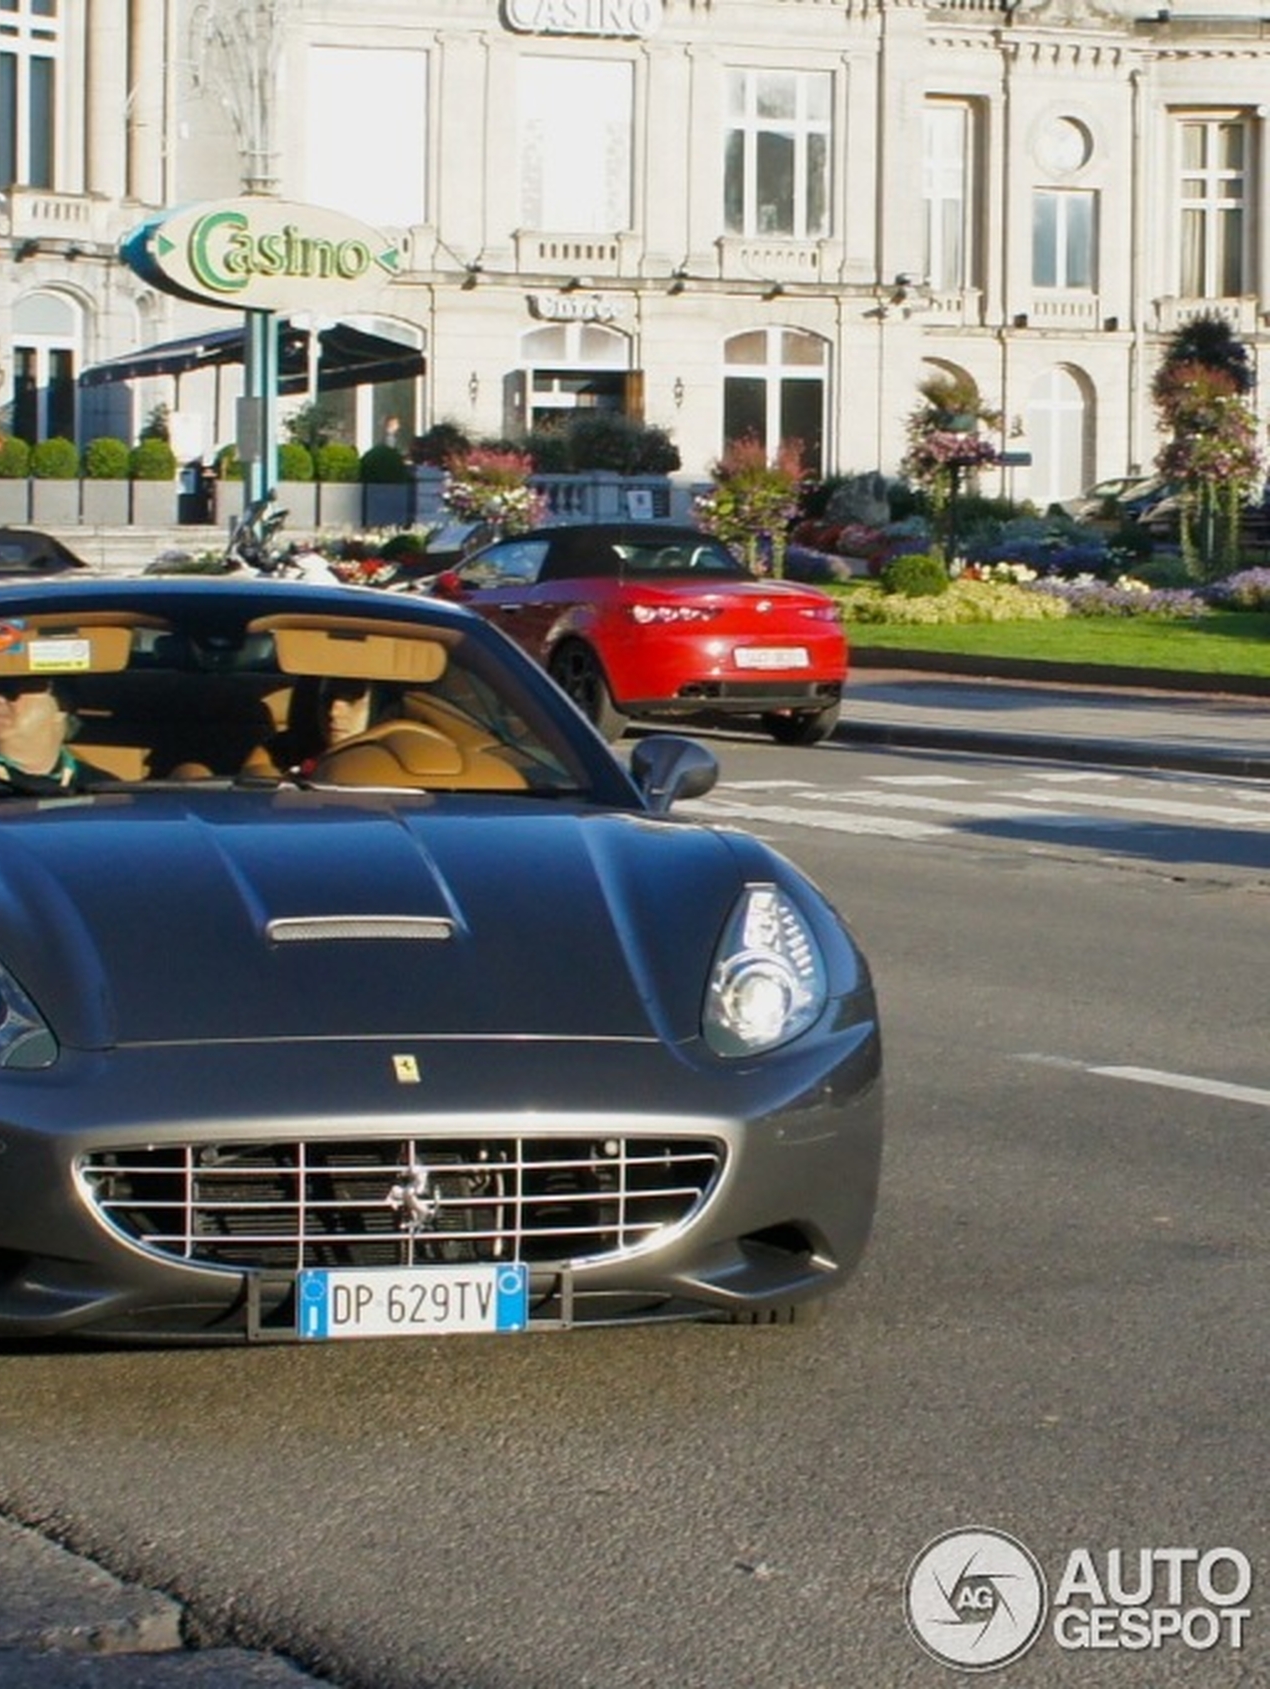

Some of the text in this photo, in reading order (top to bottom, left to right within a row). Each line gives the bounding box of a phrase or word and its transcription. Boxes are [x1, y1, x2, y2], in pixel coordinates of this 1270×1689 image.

[511, 0, 656, 35] CASINO
[187, 211, 371, 293] Casino
[332, 1284, 374, 1325] DP
[387, 1281, 493, 1324] 629TV
